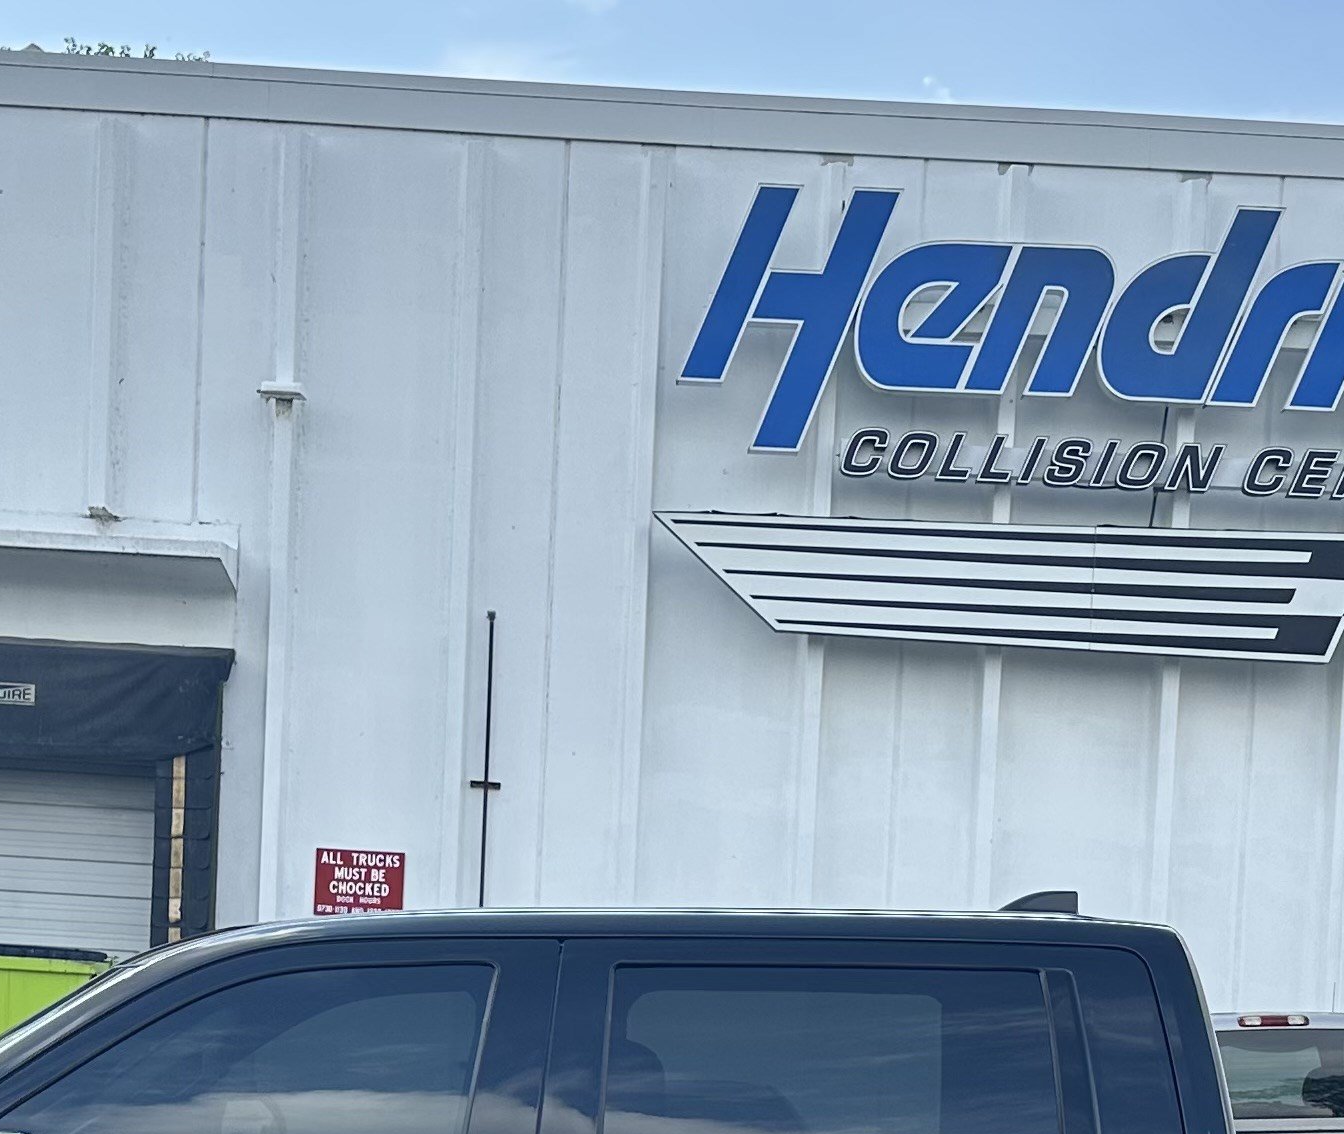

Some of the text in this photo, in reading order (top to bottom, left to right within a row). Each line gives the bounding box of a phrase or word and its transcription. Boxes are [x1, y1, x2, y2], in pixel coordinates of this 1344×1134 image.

[838, 426, 1227, 494] COLLISION
[321, 851, 401, 868] ALL TRUCKS
[334, 866, 386, 882] MUST BE
[328, 880, 390, 897] CHOCKED
